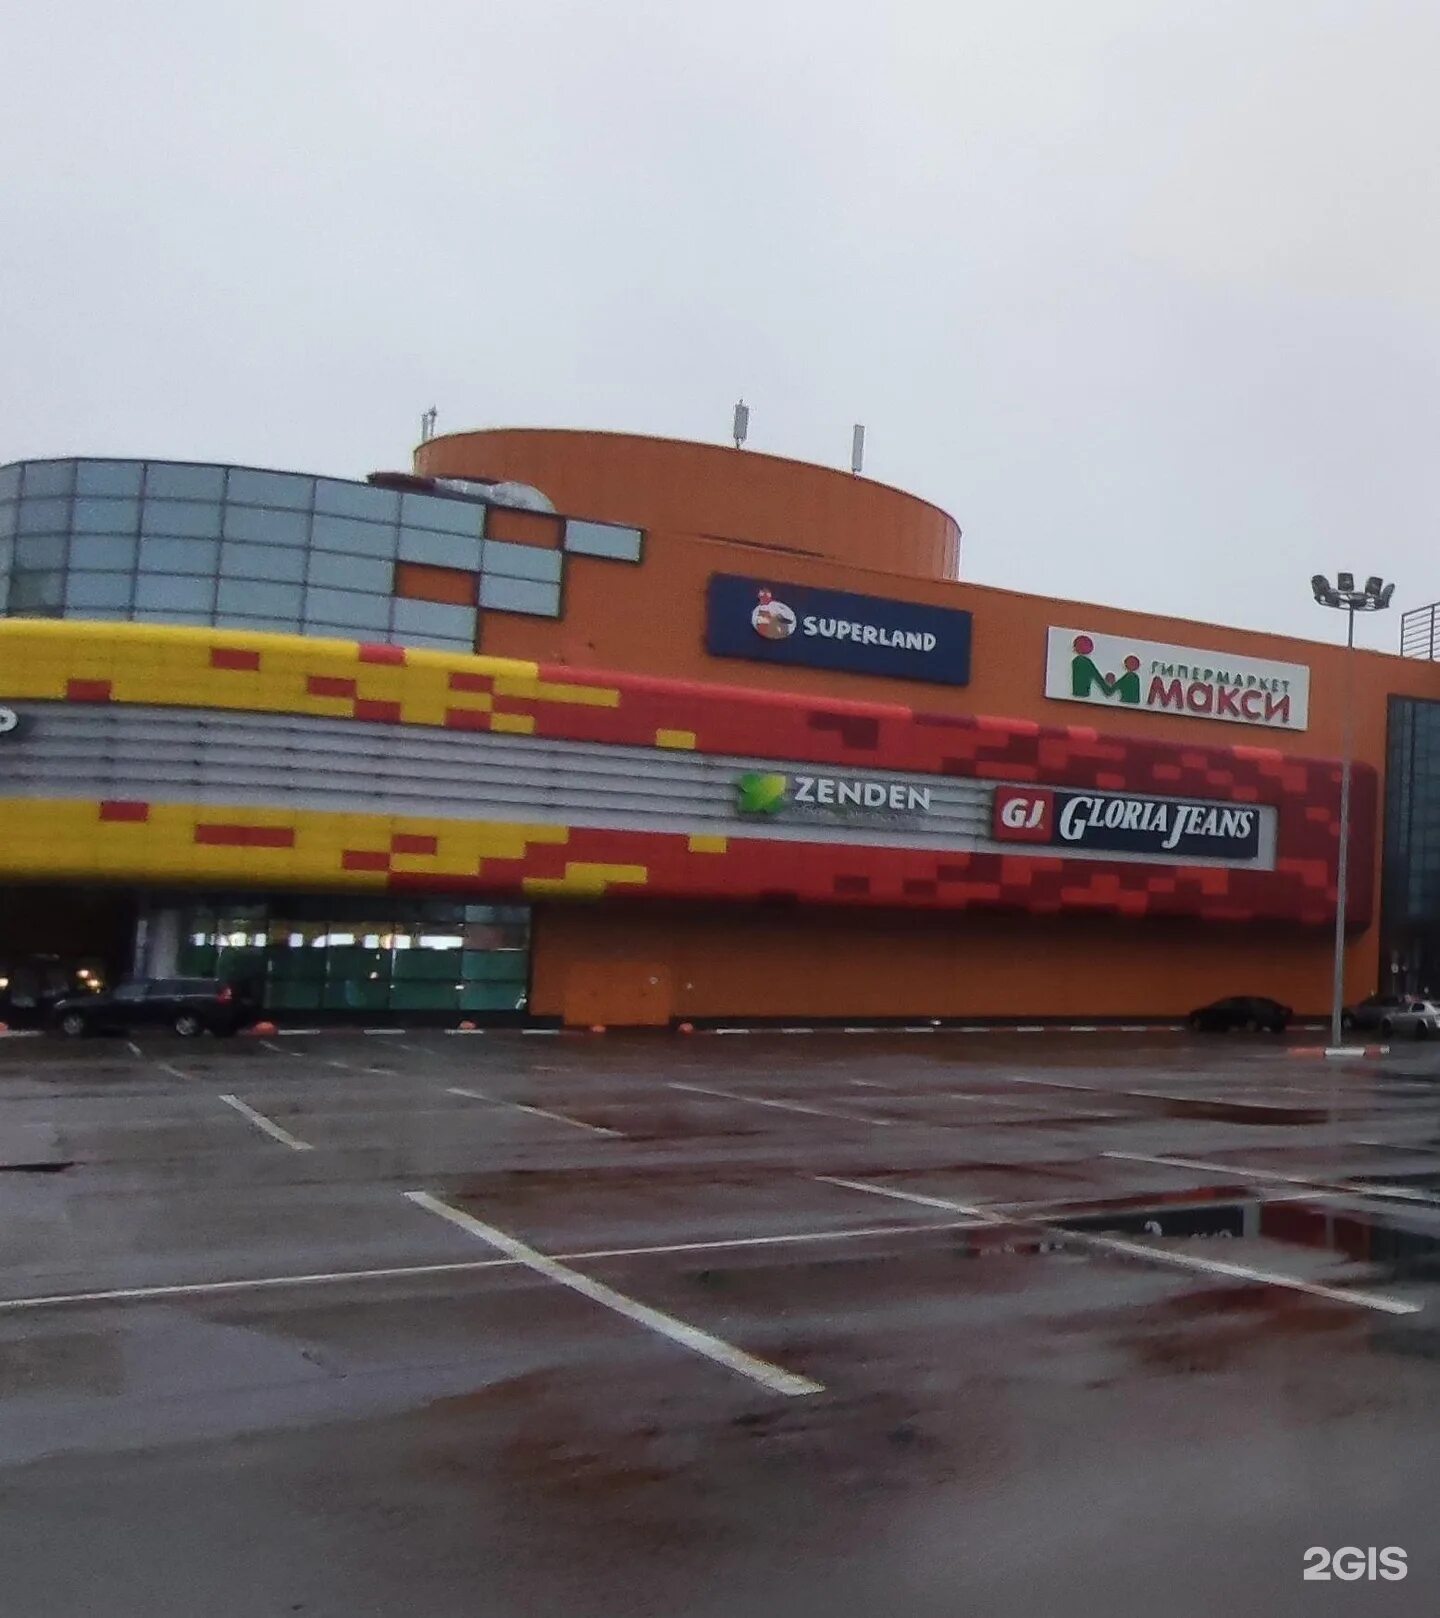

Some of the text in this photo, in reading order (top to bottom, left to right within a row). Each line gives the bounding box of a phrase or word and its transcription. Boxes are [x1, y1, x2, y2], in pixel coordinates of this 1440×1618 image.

[803, 615, 937, 651] SUPERLAND
[1151, 660, 1290, 693] ГИПЕРМАРКЕТ
[794, 776, 931, 811] ZENDEN
[1002, 798, 1045, 829] GJ
